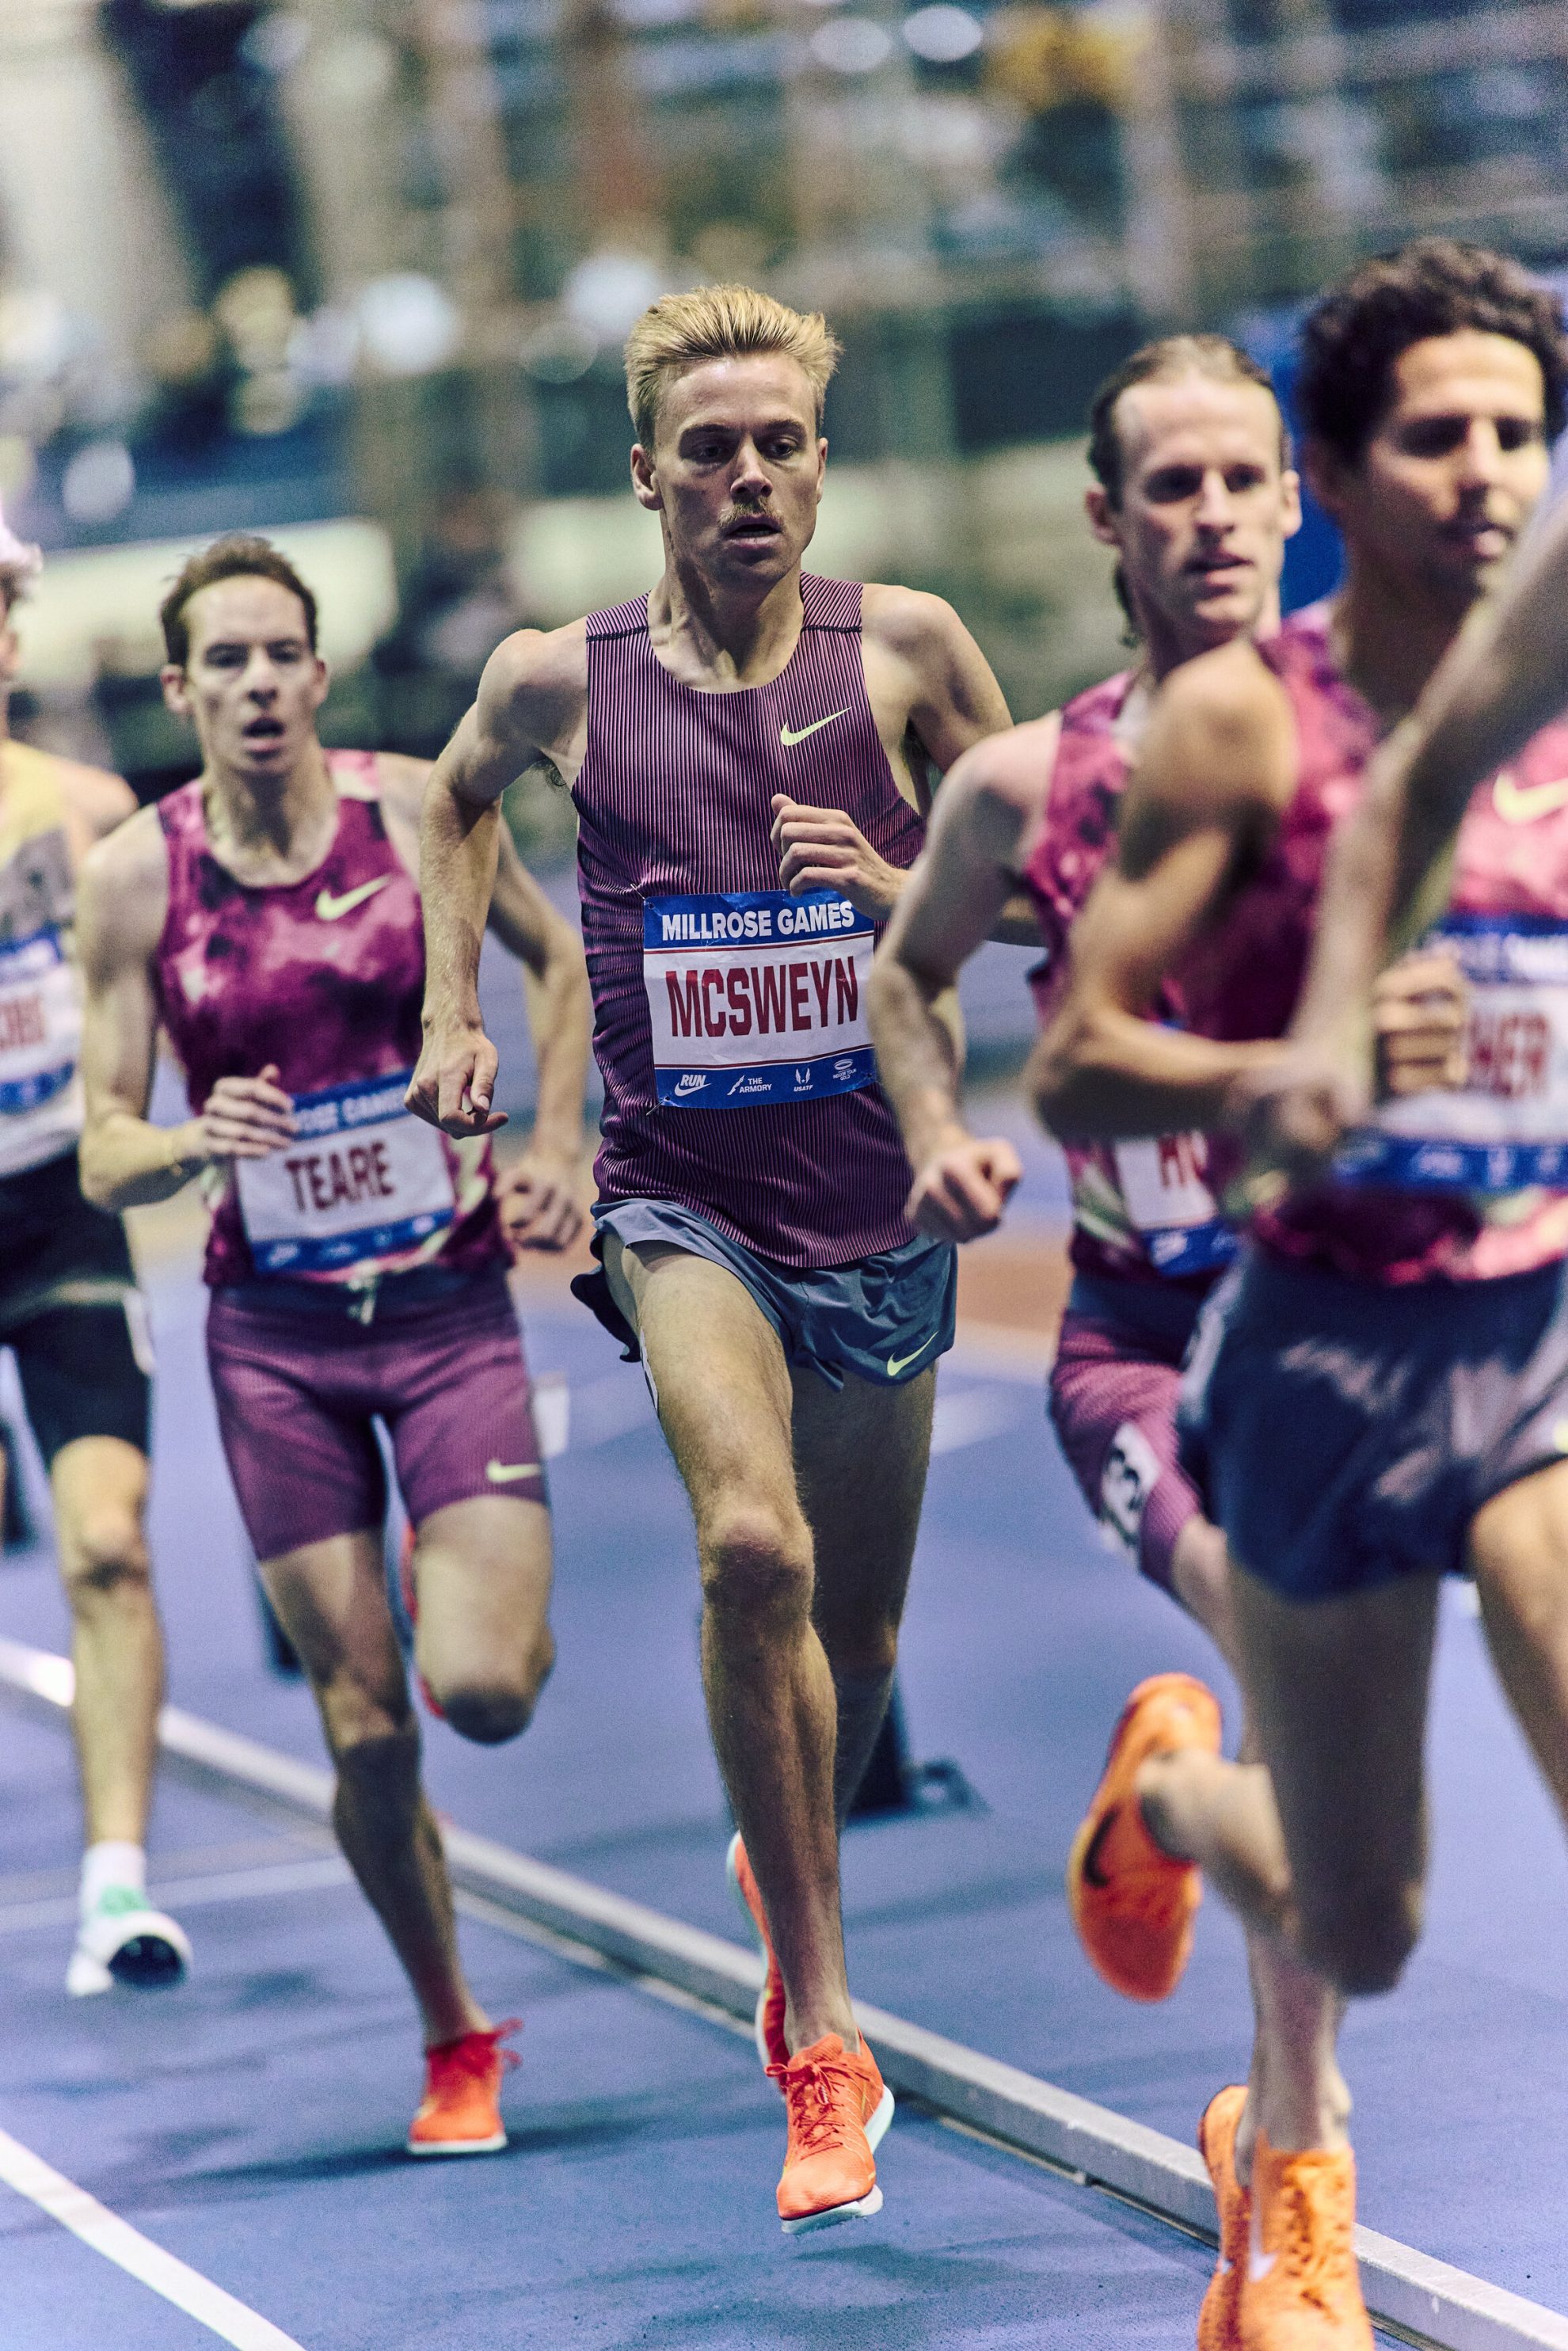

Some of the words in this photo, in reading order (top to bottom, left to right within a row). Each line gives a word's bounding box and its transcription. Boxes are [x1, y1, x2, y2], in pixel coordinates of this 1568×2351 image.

[661, 909, 772, 942] MILLROSE
[777, 900, 854, 935] GAMES
[665, 955, 858, 1038] MCSWEYN
[681, 1075, 706, 1087] RUN
[739, 1084, 772, 1094] ARMORY
[285, 1140, 394, 1212] TEARE
